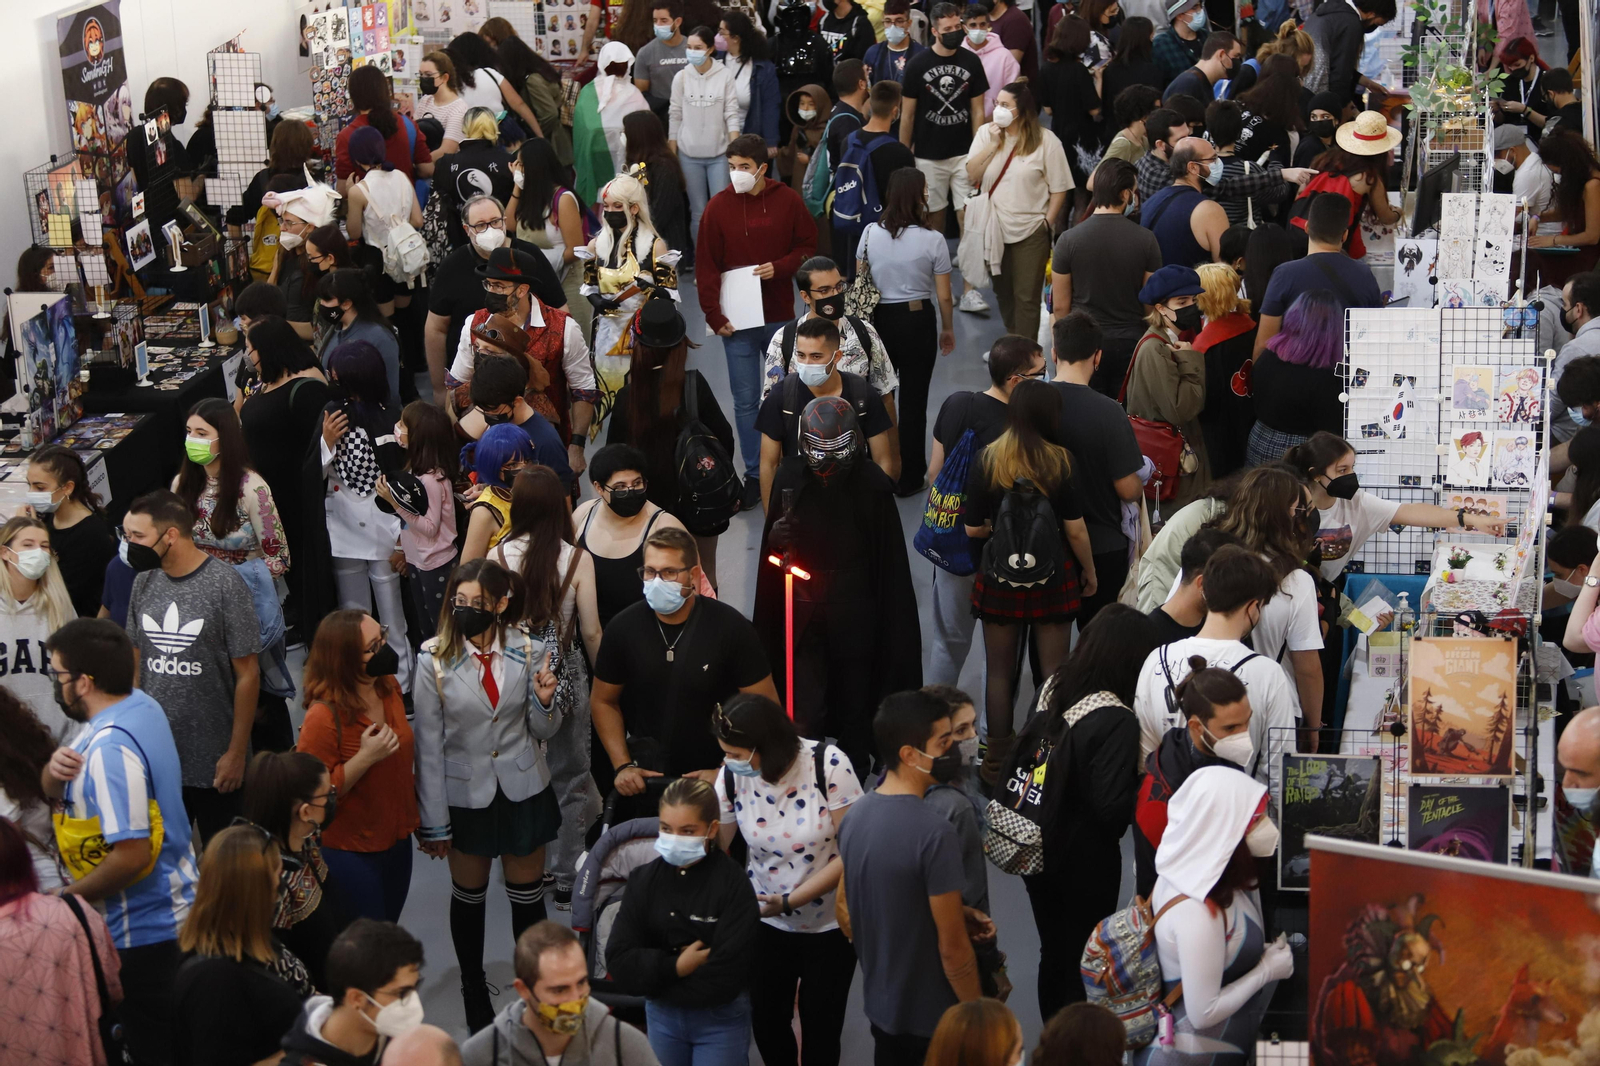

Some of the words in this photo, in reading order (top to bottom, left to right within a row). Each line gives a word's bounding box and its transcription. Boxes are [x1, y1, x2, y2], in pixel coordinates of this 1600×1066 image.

[928, 65, 966, 79] NEGAN
[942, 493, 961, 511] HARD
[937, 511, 960, 529] FAST
[147, 655, 203, 676] adidas
[1445, 659, 1481, 675] GIANT
[1286, 777, 1296, 787] OF
[1418, 798, 1436, 813] DAY
[1438, 798, 1448, 806] OF
[1421, 803, 1466, 827] TENTACLE
